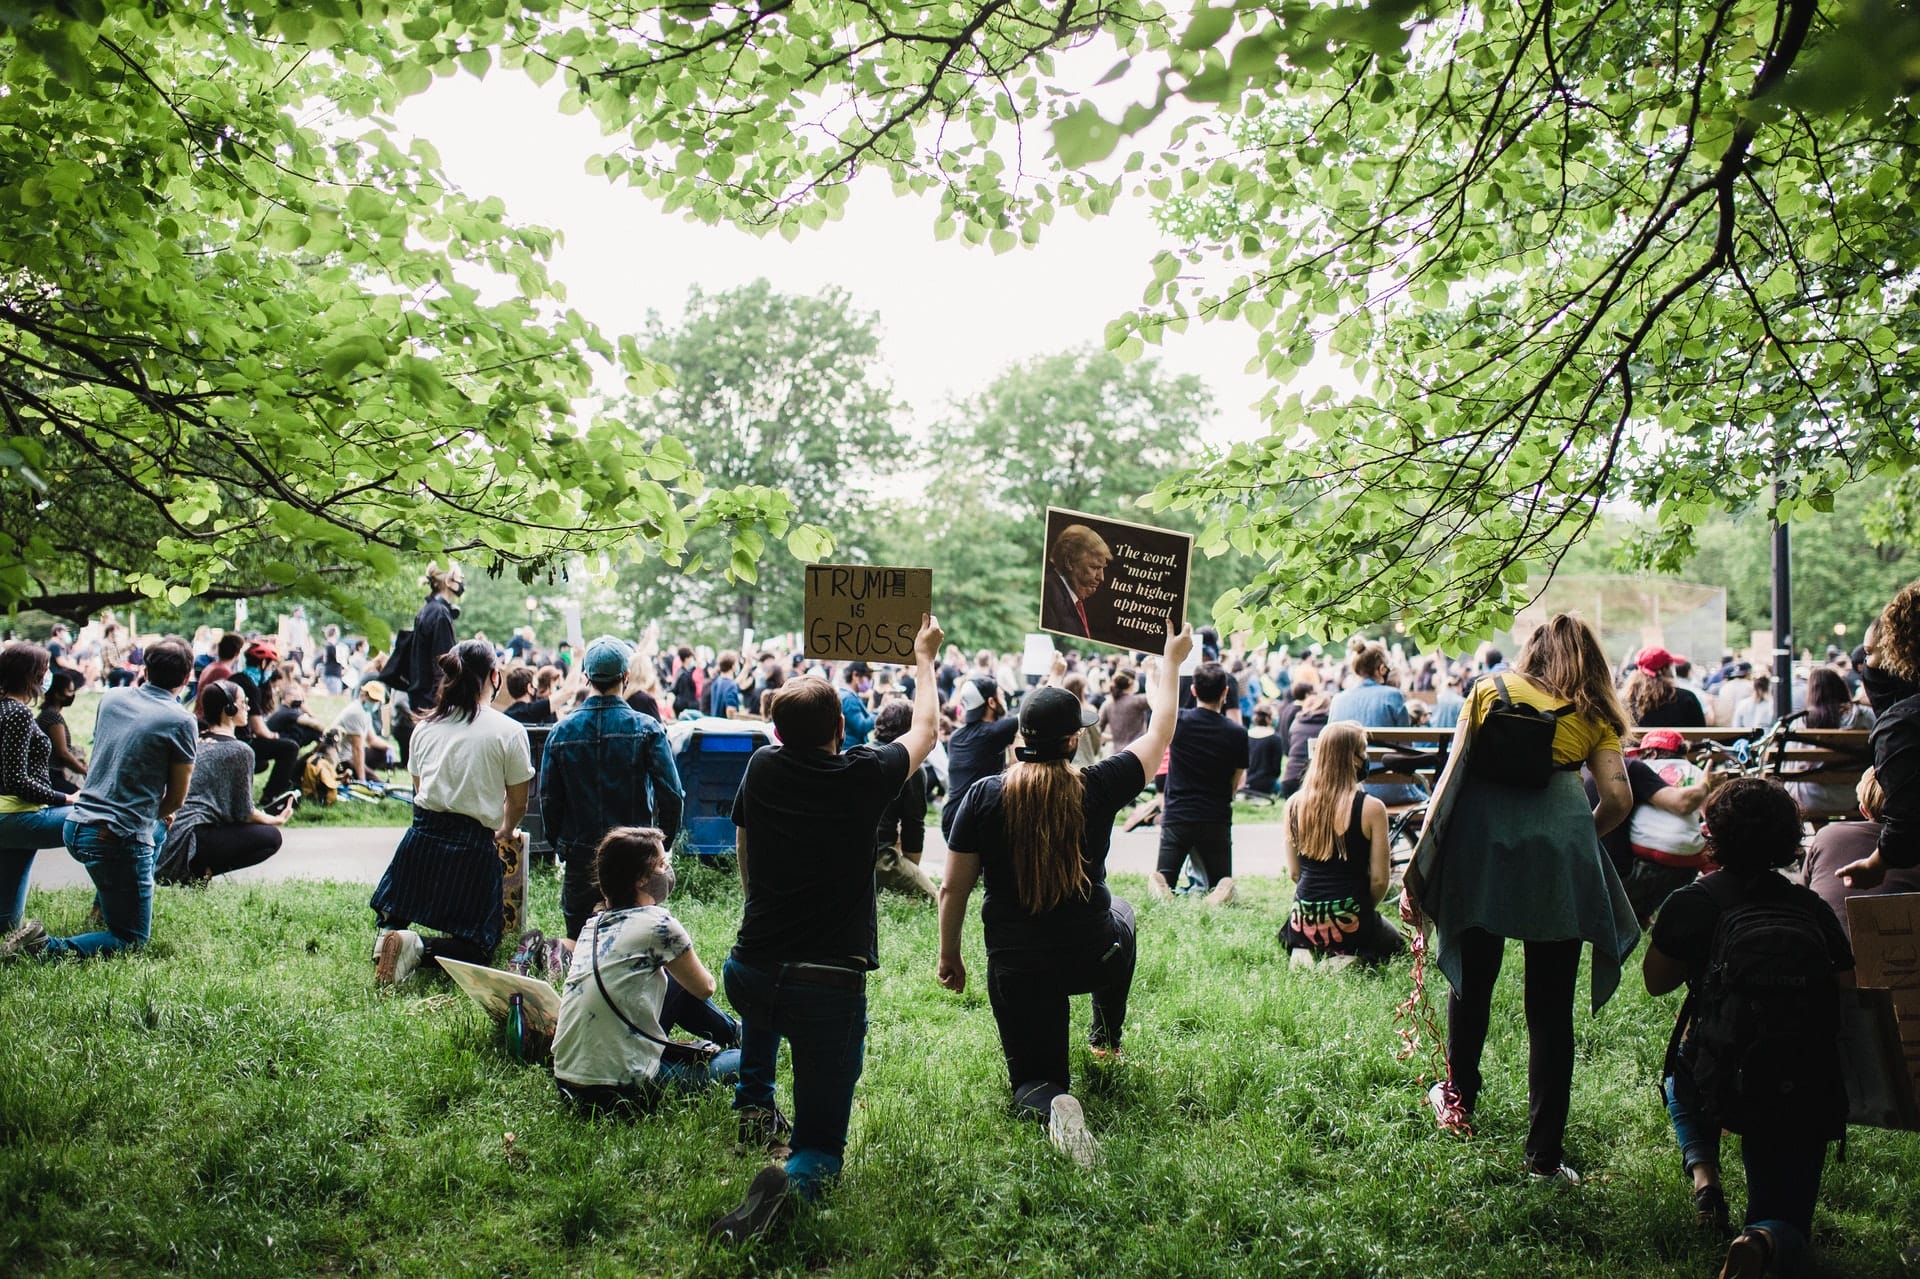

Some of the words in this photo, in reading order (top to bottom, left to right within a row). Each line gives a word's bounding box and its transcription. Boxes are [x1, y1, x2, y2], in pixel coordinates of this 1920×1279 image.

[1116, 543, 1140, 560] The
[1111, 578, 1133, 593] has
[1135, 584, 1178, 603] higher
[850, 603, 865, 618] IS
[1113, 598, 1173, 619] approval
[1116, 615, 1164, 635] ratings.
[810, 617, 915, 657] GROSS
